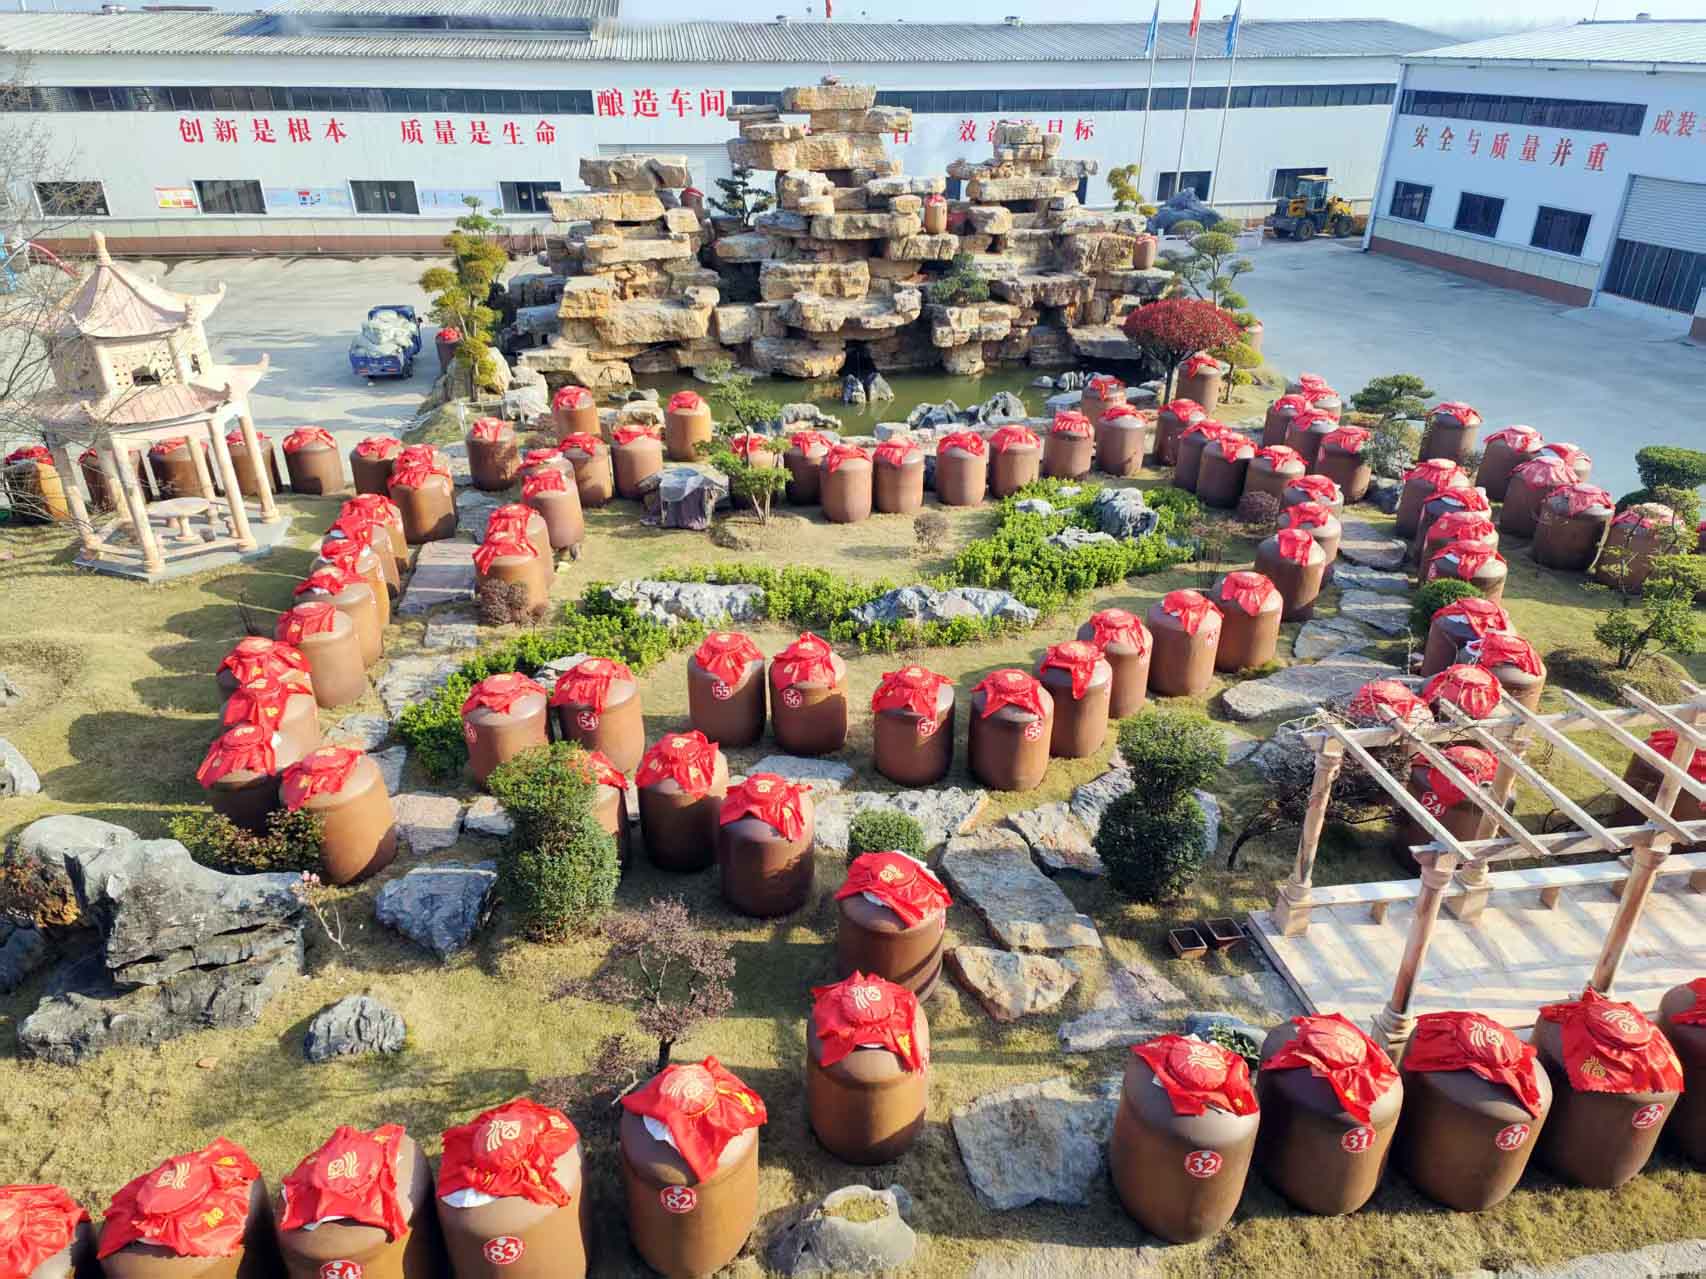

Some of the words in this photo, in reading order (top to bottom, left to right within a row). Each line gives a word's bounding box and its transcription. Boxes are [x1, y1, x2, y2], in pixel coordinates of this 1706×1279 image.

[597, 88, 726, 118] 酿造车间
[178, 117, 347, 145] 创新是根本
[400, 119, 557, 145] 质量是生命
[1412, 124, 1609, 171] 安全与质量并重
[715, 686, 730, 698] 55
[580, 715, 596, 728] 54
[1635, 1111, 1661, 1125] 29
[1345, 1134, 1369, 1150] 31
[1500, 1131, 1527, 1146] 30
[1190, 1157, 1217, 1173] 32
[666, 1193, 692, 1209] 82
[490, 1243, 519, 1261] 83
